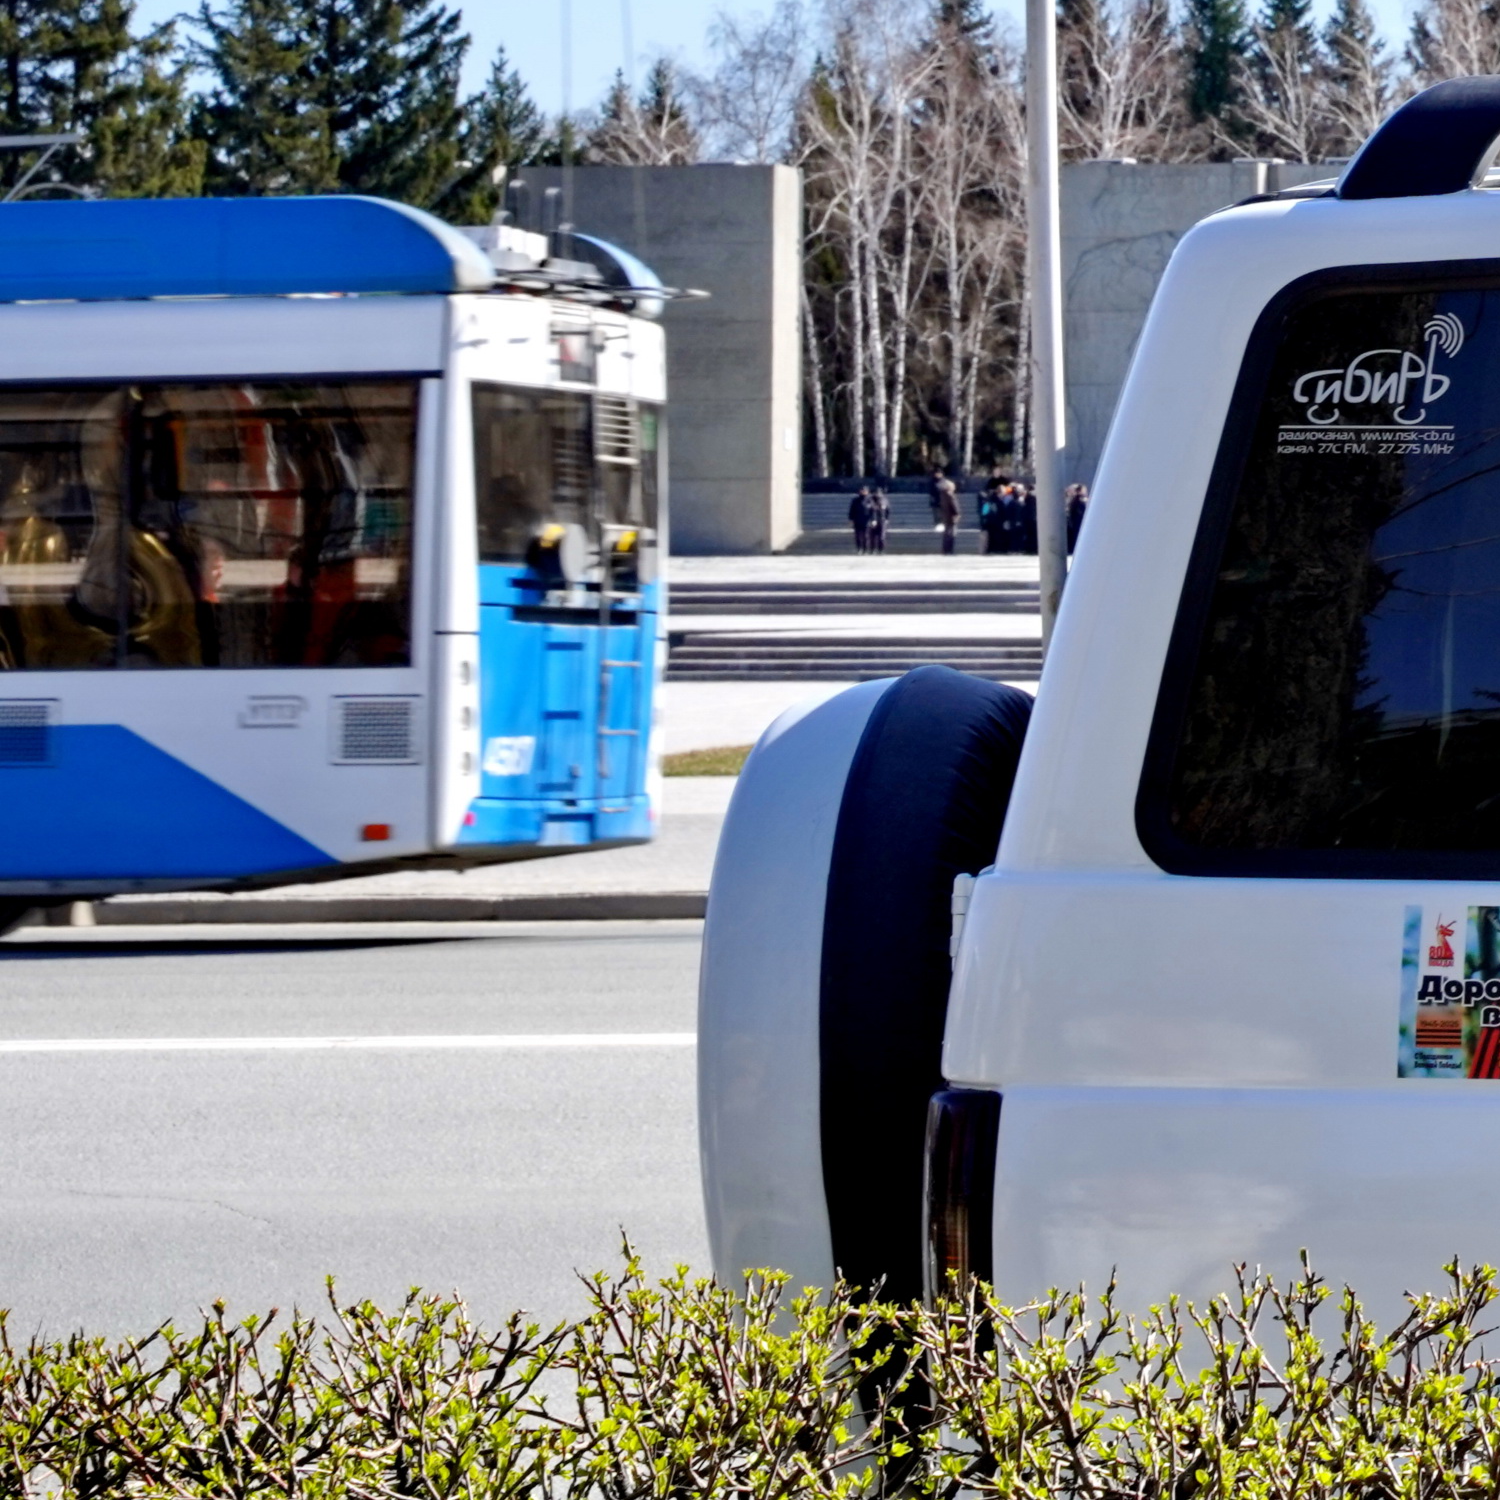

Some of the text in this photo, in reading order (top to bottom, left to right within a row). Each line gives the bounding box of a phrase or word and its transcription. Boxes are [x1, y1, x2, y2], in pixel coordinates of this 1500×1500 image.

[1278, 432, 1356, 442] радиоканал
[1277, 445, 1314, 454] канал
[1424, 444, 1455, 454] MHz
